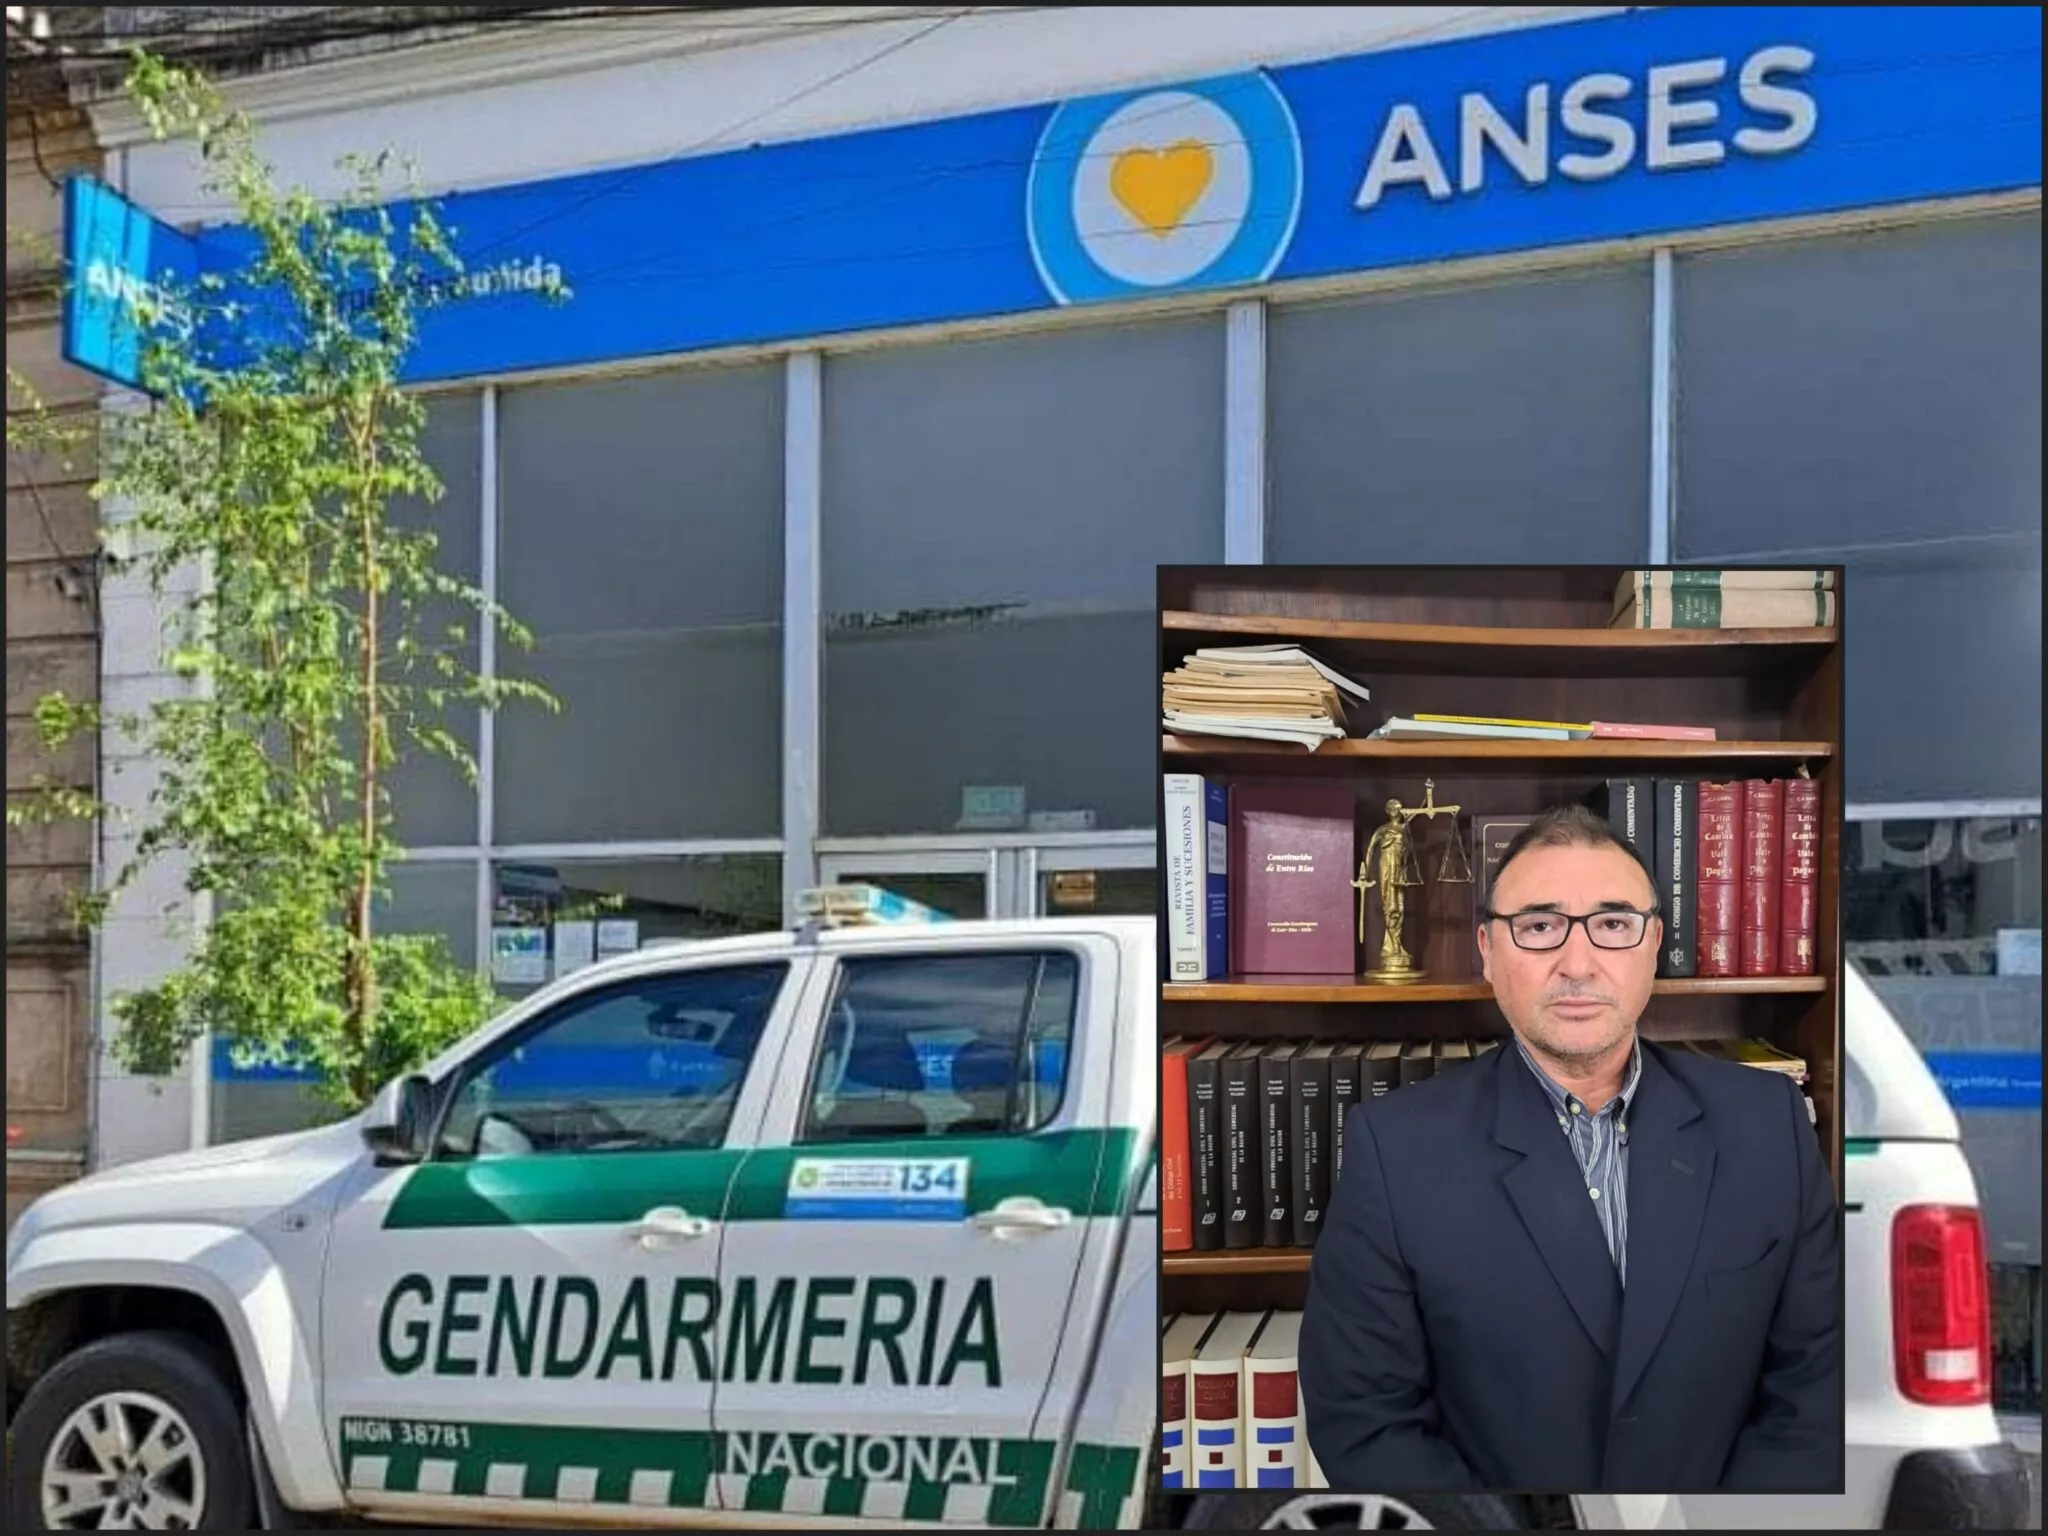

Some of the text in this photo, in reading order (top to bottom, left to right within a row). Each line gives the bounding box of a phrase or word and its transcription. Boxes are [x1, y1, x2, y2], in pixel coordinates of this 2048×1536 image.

[1355, 45, 1818, 208] ANSES
[1627, 786, 1635, 837] COMENTADO
[1674, 785, 1682, 836] COMENTADO
[1173, 855, 1182, 910] REVISTA DE
[1182, 805, 1195, 935] FAMILIA Y SUCESIONES
[1266, 863, 1314, 872] de Entre Ríos
[1673, 883, 1681, 895] DE
[900, 1164, 957, 1192] 134
[378, 1273, 1002, 1388] GENDARMERIA
[400, 1423, 470, 1448] 38781
[726, 1431, 1016, 1484] NACIONAL
